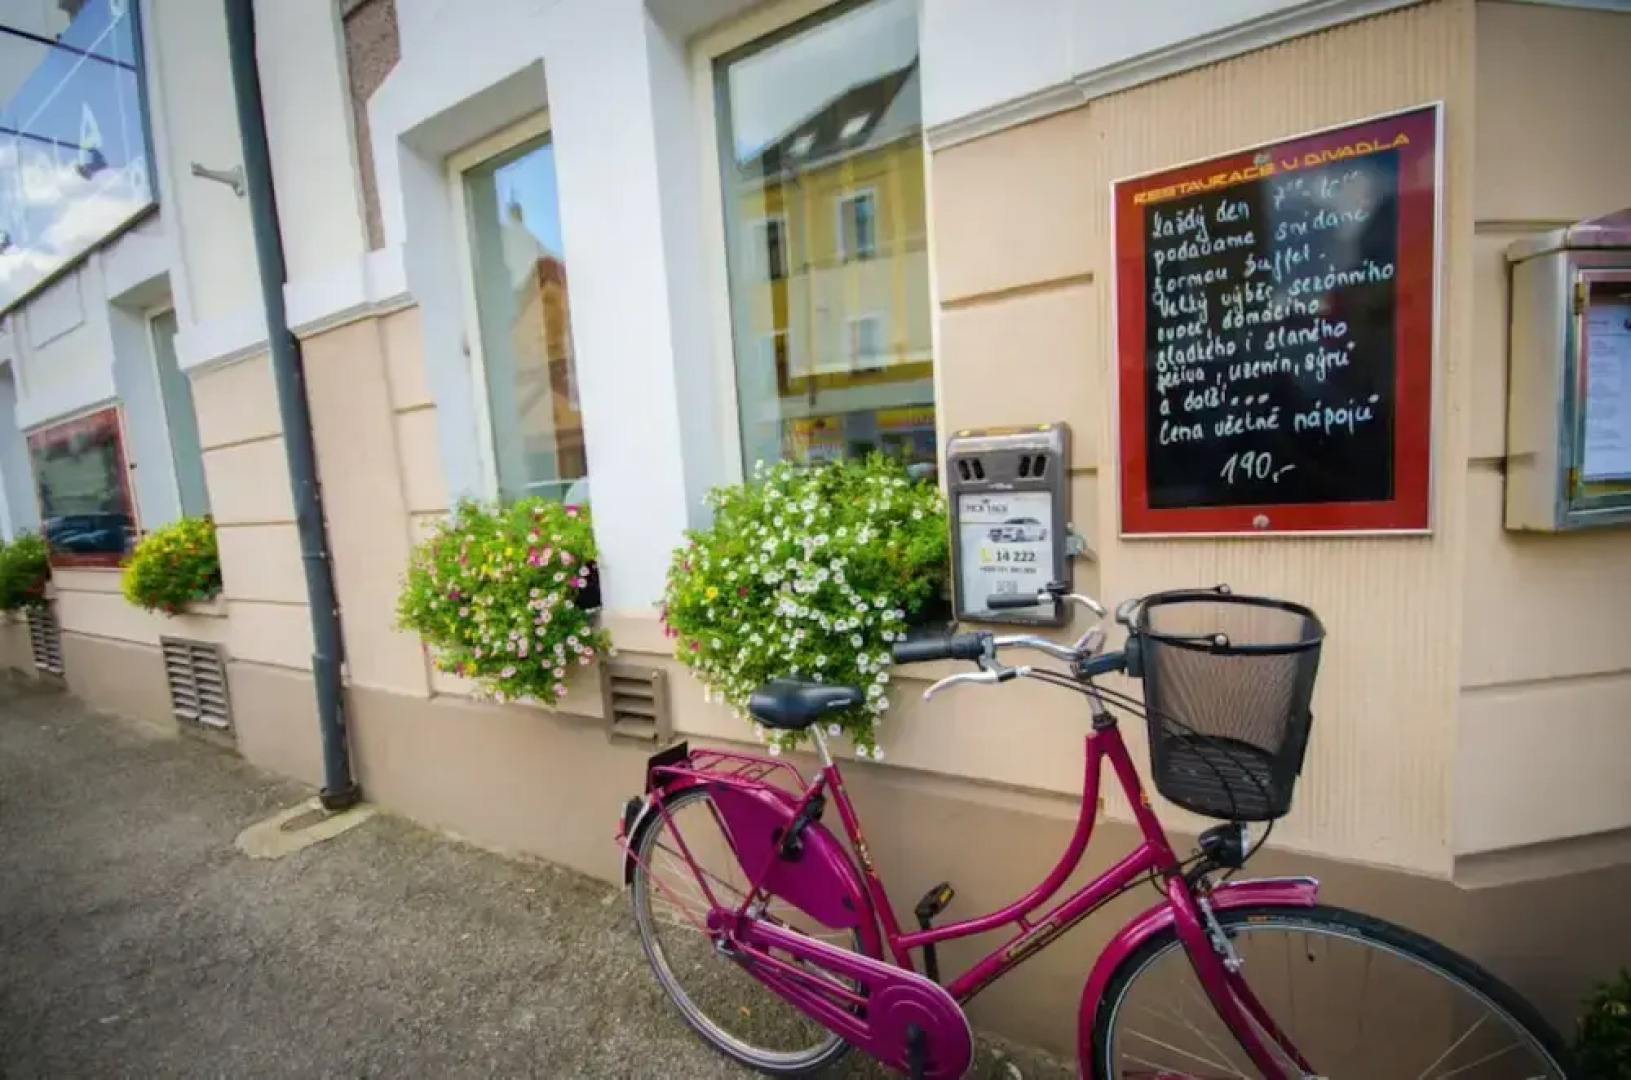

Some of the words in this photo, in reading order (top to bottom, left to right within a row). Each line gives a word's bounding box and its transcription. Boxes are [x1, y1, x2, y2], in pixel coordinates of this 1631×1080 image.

[1304, 132, 1410, 167] DIVADLA
[1152, 203, 1210, 242] Každý
[1216, 199, 1250, 223] den
[1287, 259, 1394, 296] sezónního
[1222, 296, 1320, 330] domácího
[1156, 335, 1237, 373] sladkého
[1245, 330, 1254, 352] i
[1263, 317, 1348, 352] slaného
[1158, 397, 1171, 416] a
[1158, 418, 1205, 446] Cena
[1218, 450, 1297, 486] 190,-
[996, 549, 1011, 562] 14
[1013, 549, 1036, 562] 222
